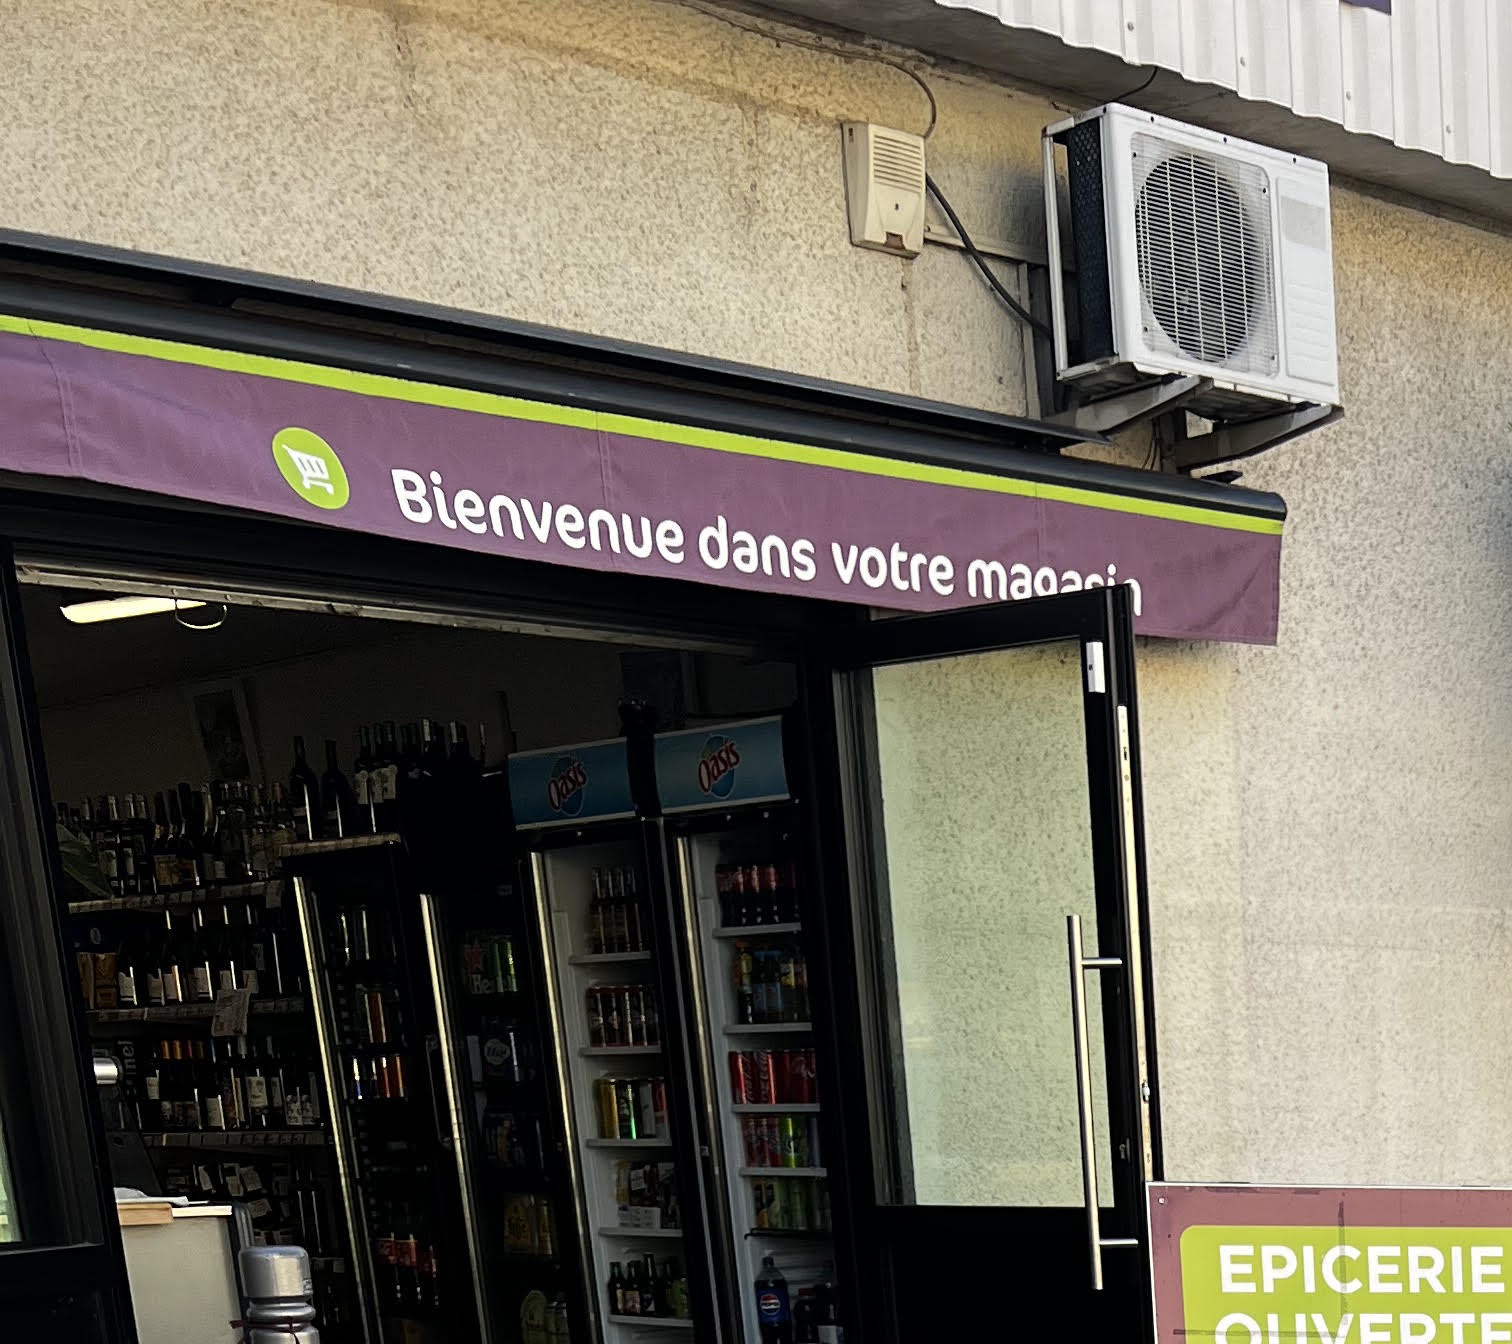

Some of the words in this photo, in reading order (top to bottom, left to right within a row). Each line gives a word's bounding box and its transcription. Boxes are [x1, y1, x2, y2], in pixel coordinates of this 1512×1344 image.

[391, 468, 685, 564] Bienvenue
[698, 515, 818, 582] dans
[831, 541, 955, 596] votre
[547, 760, 588, 812] Oasis
[698, 739, 741, 793] Oasis
[1218, 1244, 1506, 1294] EPICERIE
